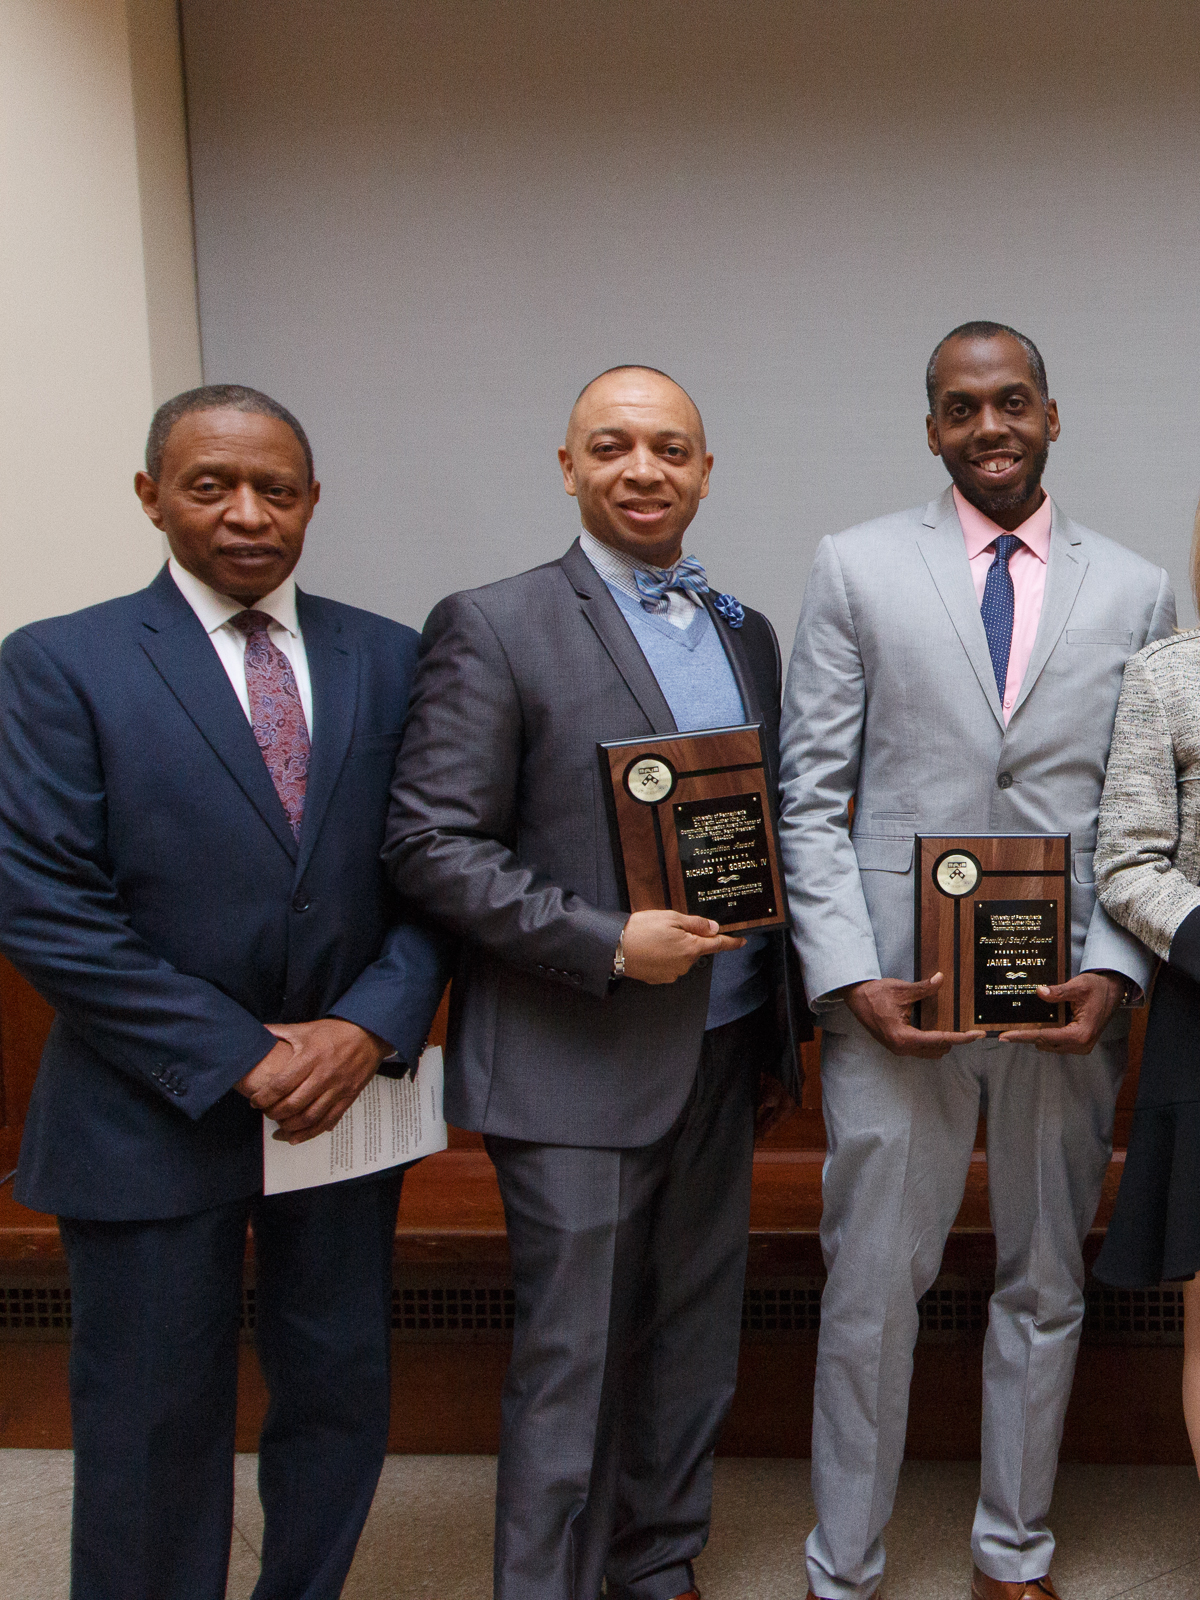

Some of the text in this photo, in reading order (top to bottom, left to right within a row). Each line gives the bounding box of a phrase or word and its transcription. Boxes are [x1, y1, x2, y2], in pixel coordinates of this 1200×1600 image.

[693, 840, 755, 857] Recognition Award
[686, 867, 713, 877] RICHARD
[728, 860, 758, 871] GORDON,
